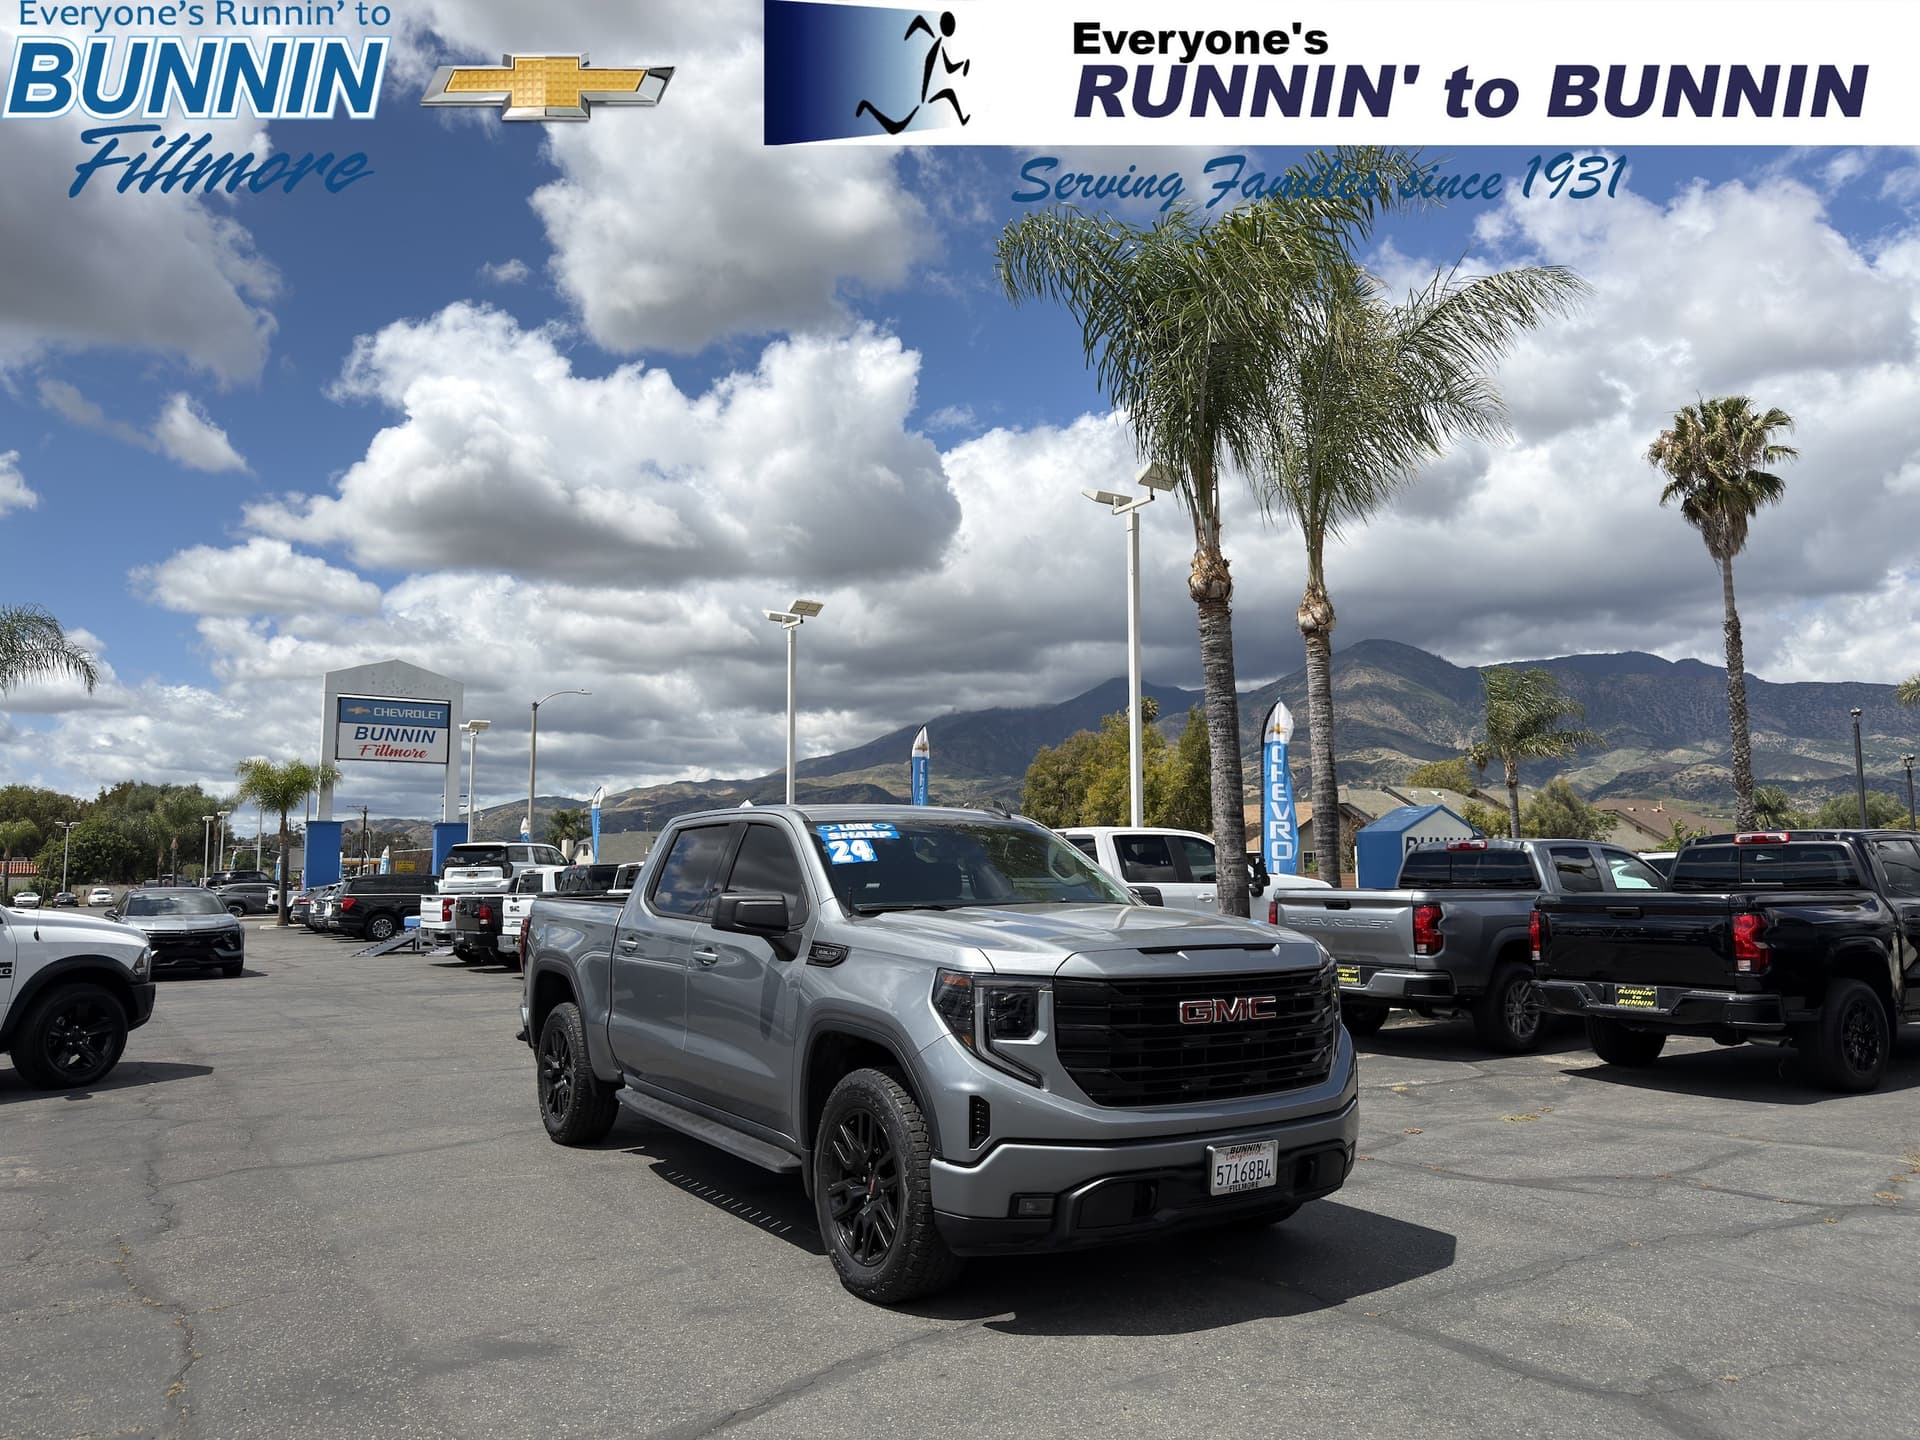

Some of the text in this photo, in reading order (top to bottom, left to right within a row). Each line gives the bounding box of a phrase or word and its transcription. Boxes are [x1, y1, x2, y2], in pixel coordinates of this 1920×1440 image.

[373, 706, 443, 720] CHEVROLET
[354, 726, 436, 744] BUNNIN
[359, 744, 428, 758] Fillmore
[827, 830, 893, 840] SHARP
[828, 840, 874, 863] 24
[1179, 996, 1277, 1024] GMC
[1230, 1143, 1262, 1154] BUNNIN
[1216, 1158, 1271, 1186] 57168B4
[1229, 1181, 1259, 1192] FILLMORE
